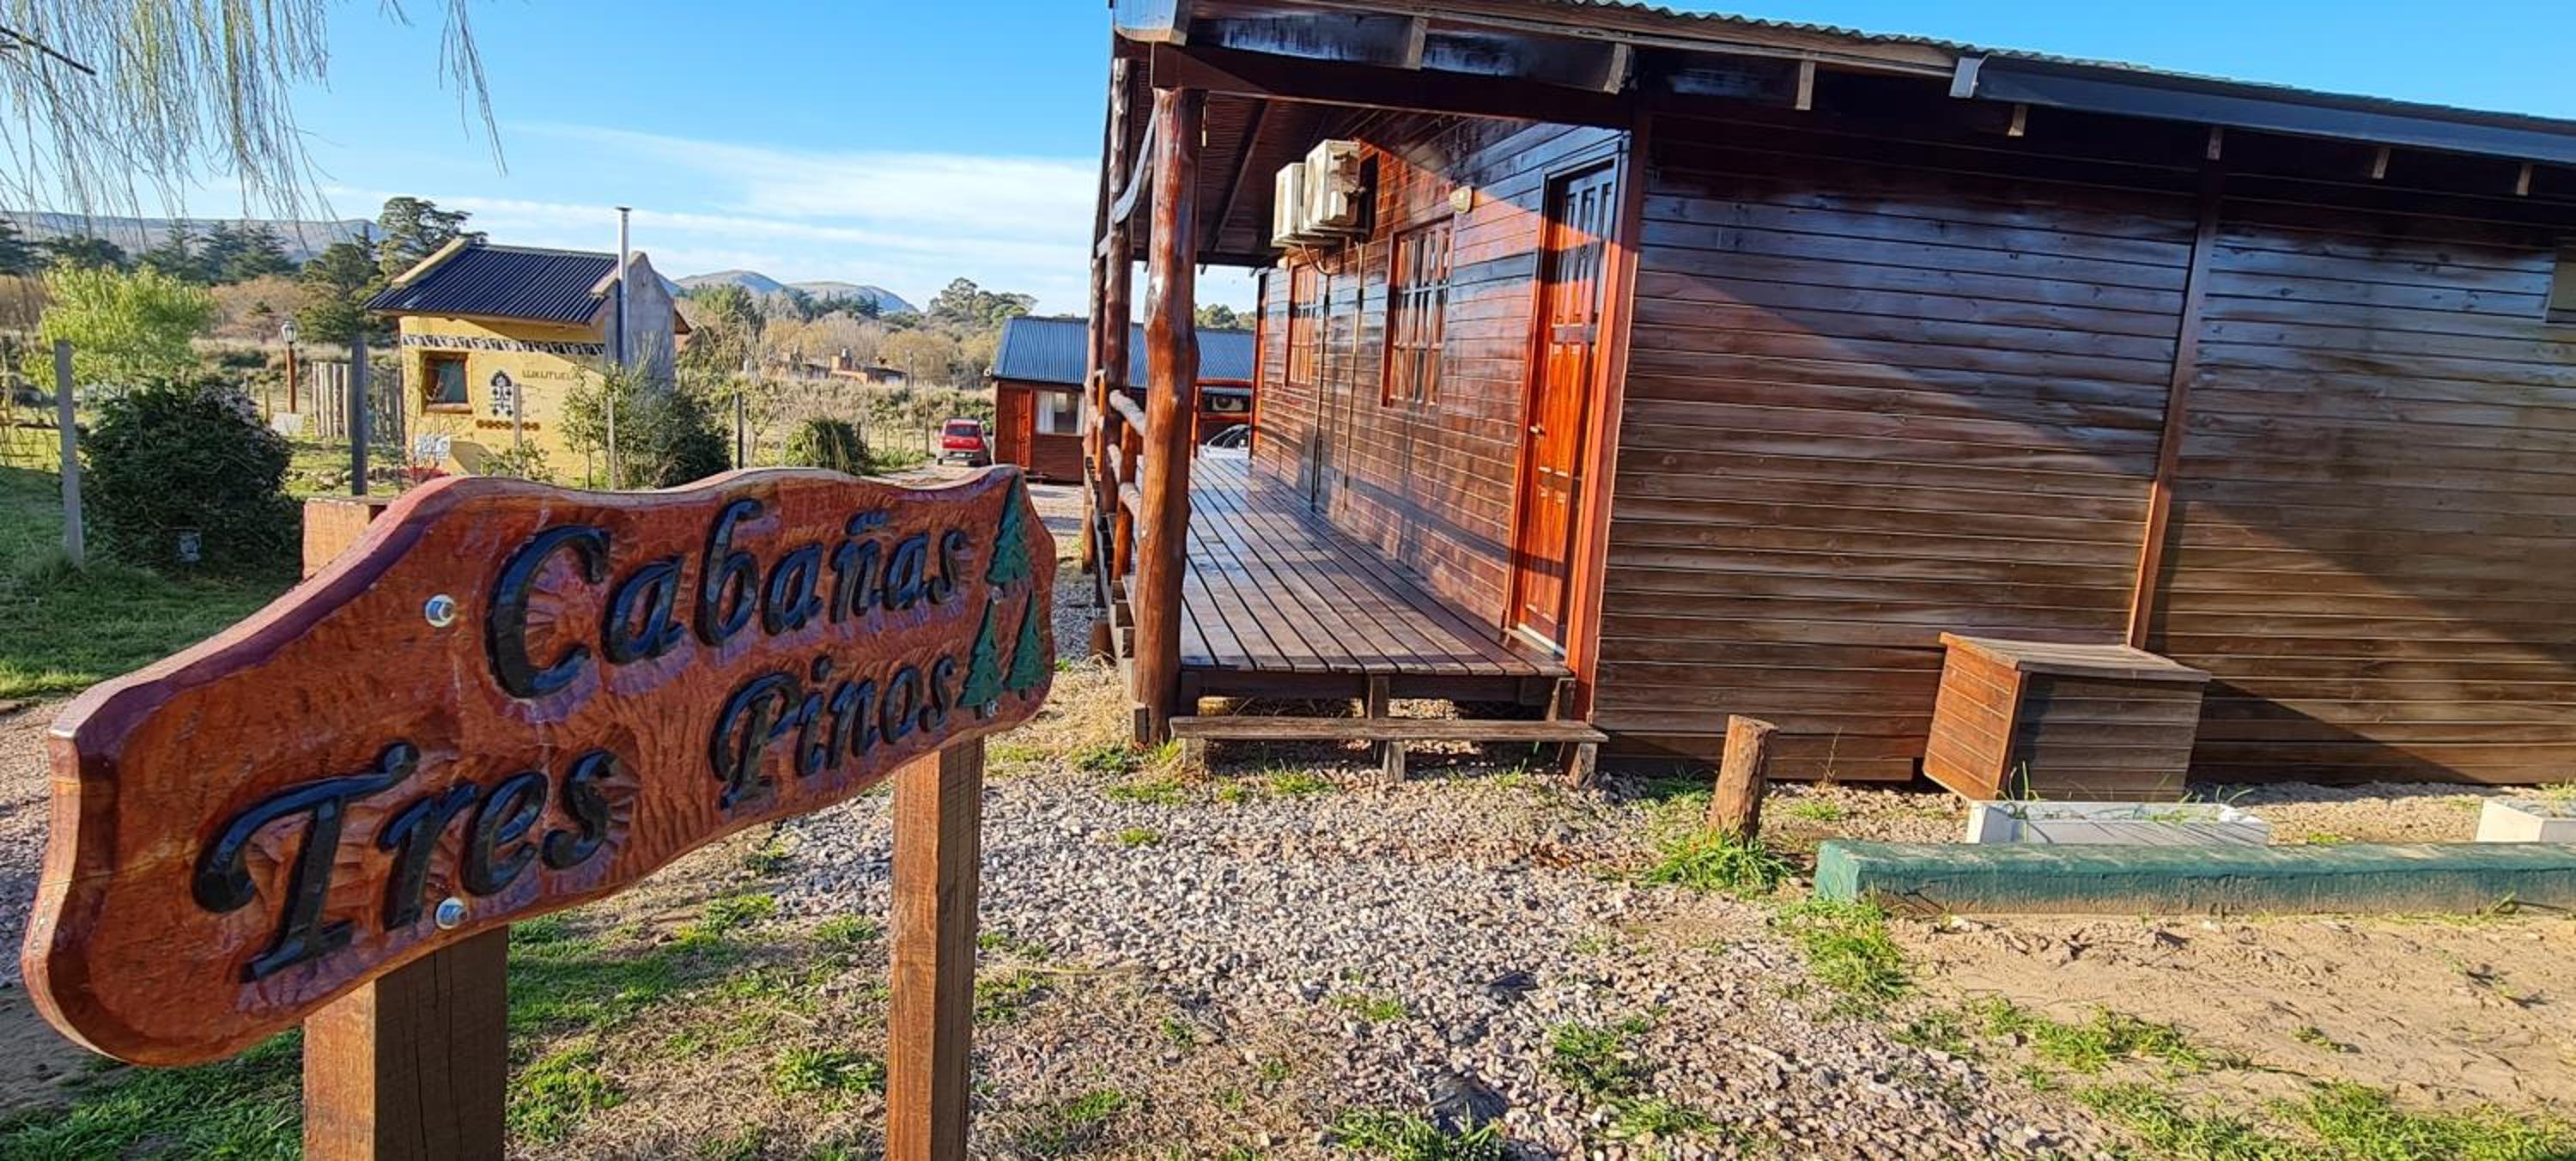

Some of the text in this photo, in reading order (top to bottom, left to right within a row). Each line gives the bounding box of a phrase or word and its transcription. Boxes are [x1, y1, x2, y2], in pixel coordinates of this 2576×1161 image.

[486, 497, 966, 701] Cabañas
[193, 654, 957, 983] Tres Pinos
